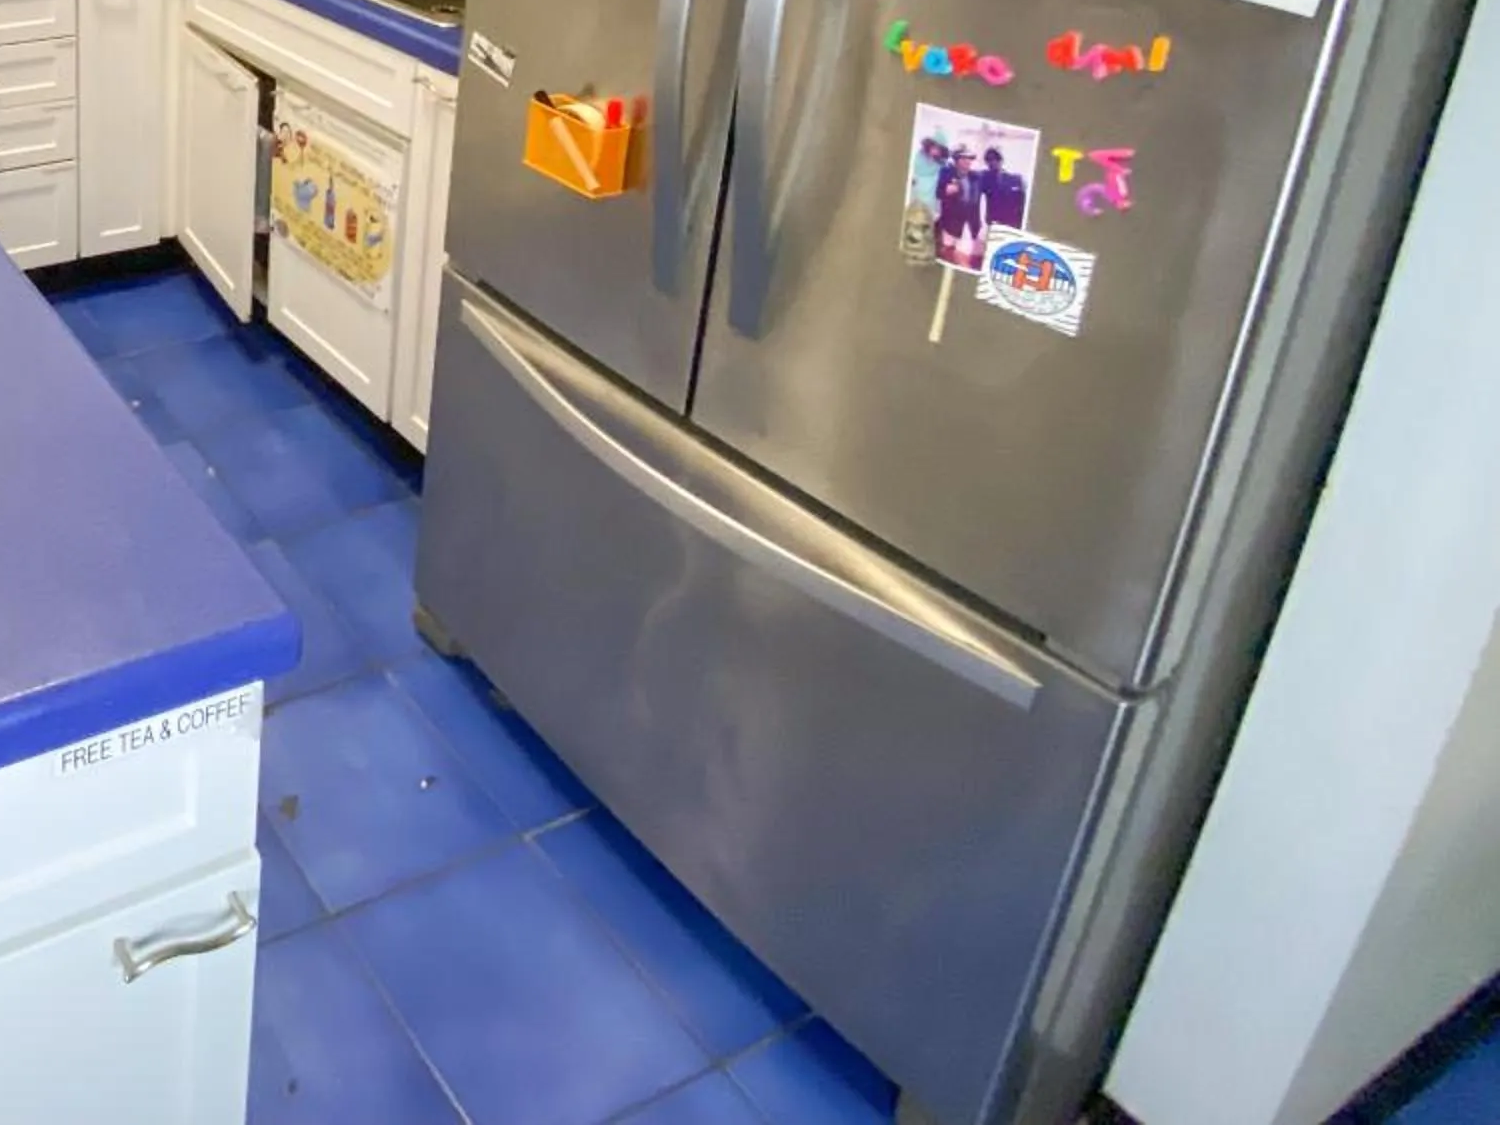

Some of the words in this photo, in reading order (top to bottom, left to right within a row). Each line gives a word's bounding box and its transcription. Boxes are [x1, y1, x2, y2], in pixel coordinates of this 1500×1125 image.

[61, 738, 113, 773] FREE
[118, 724, 155, 754] TEA
[159, 719, 172, 741] &
[176, 692, 252, 735] COFFEE
